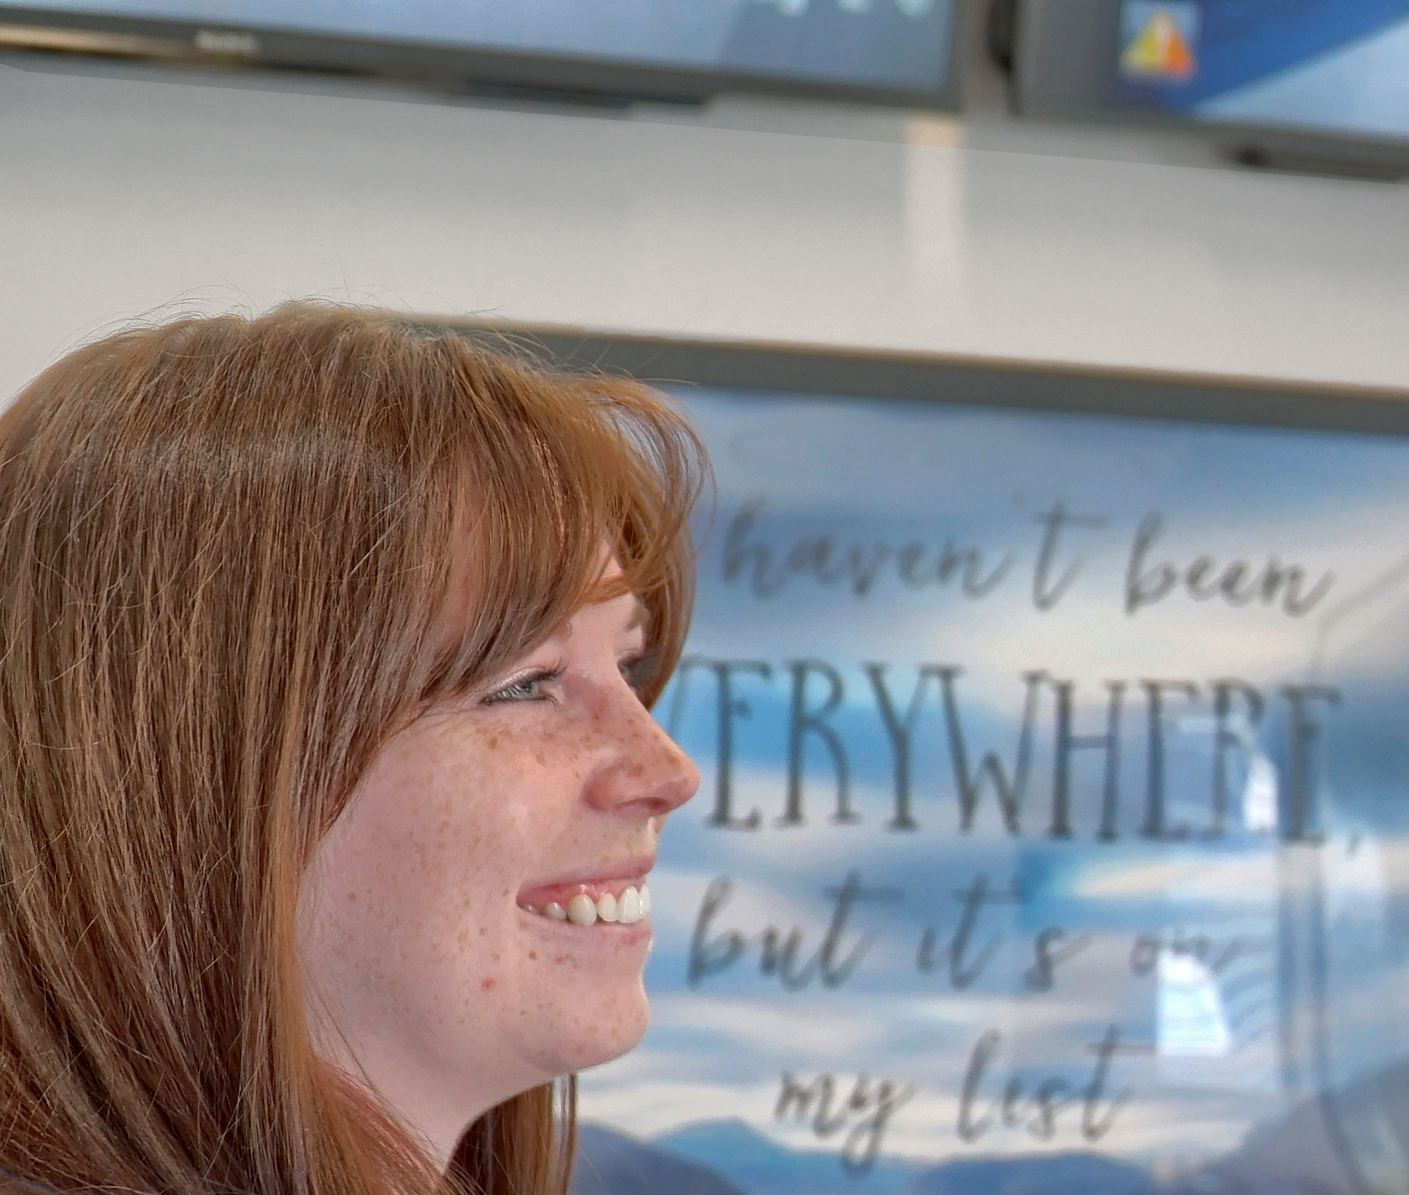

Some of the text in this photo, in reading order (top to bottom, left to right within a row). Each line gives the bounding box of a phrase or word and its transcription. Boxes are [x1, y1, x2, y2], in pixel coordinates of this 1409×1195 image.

[720, 495, 1338, 617] haven't been
[667, 655, 1364, 856] ERYWHERE,
[686, 869, 901, 991] but
[915, 870, 1092, 992] it's
[774, 1069, 914, 1176] my
